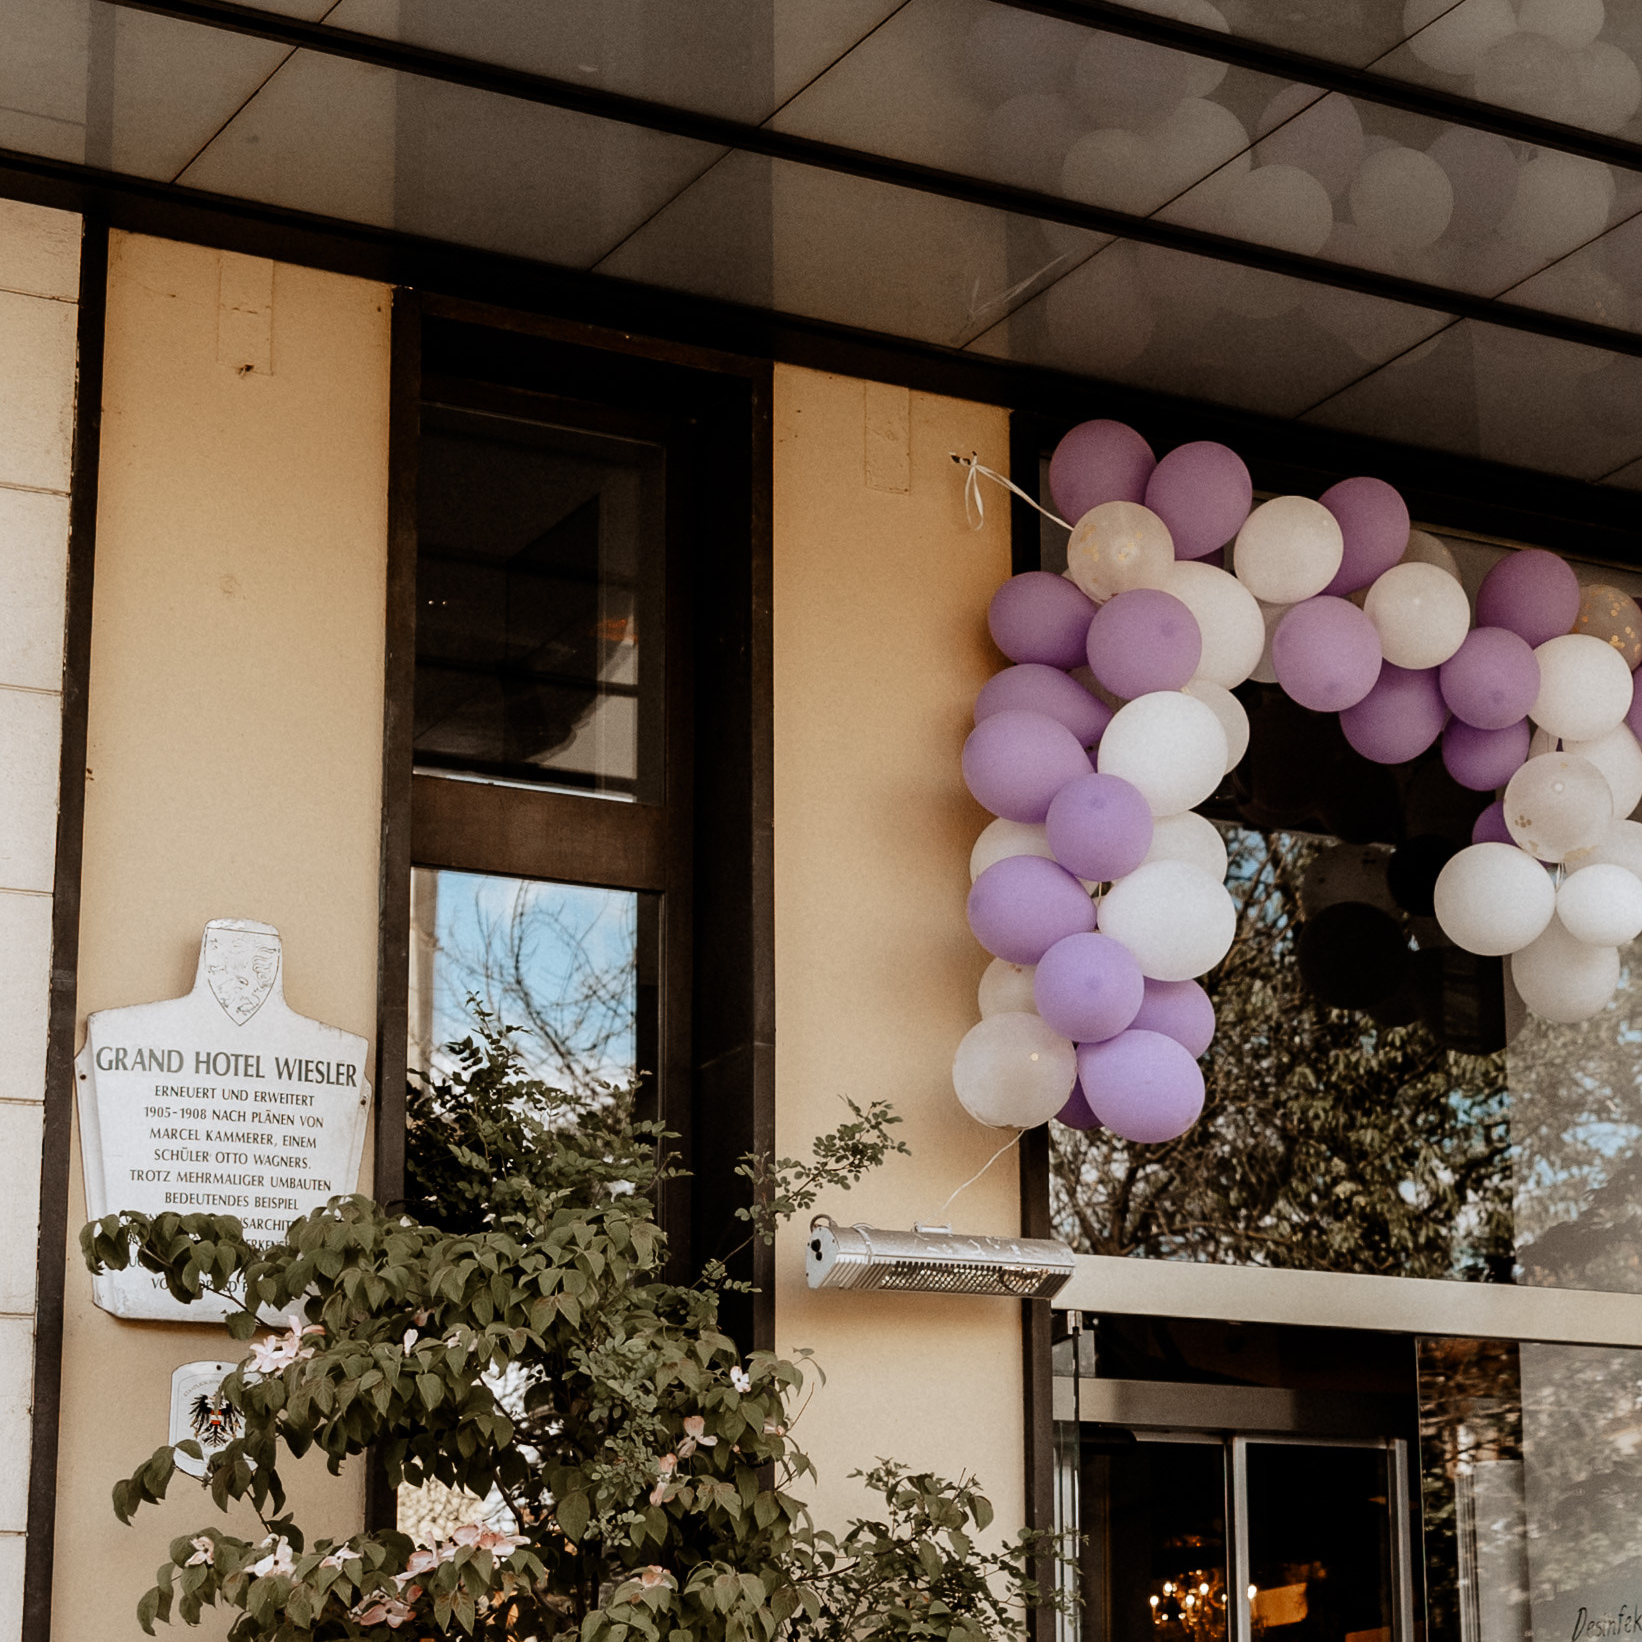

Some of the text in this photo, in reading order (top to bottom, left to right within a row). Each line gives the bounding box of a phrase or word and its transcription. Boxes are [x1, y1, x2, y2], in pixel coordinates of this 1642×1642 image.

[95, 1046, 358, 1087] GRAND HOTEL WIESLER
[154, 1085, 315, 1107] ERNEUERT UND ERWEITERT
[212, 1110, 246, 1123] NACH
[251, 1109, 295, 1127] PLÄNEN
[300, 1115, 324, 1128] VON
[149, 1127, 317, 1149] MARCEL KAMMERER, EINEM
[153, 1146, 312, 1170] SCHÜLER OTTO WAGNERS.
[129, 1169, 332, 1192] TROTZ MEHRMALIGER UMBAUTEN
[164, 1191, 299, 1210] BEDEUTENDES BEISPIEL
